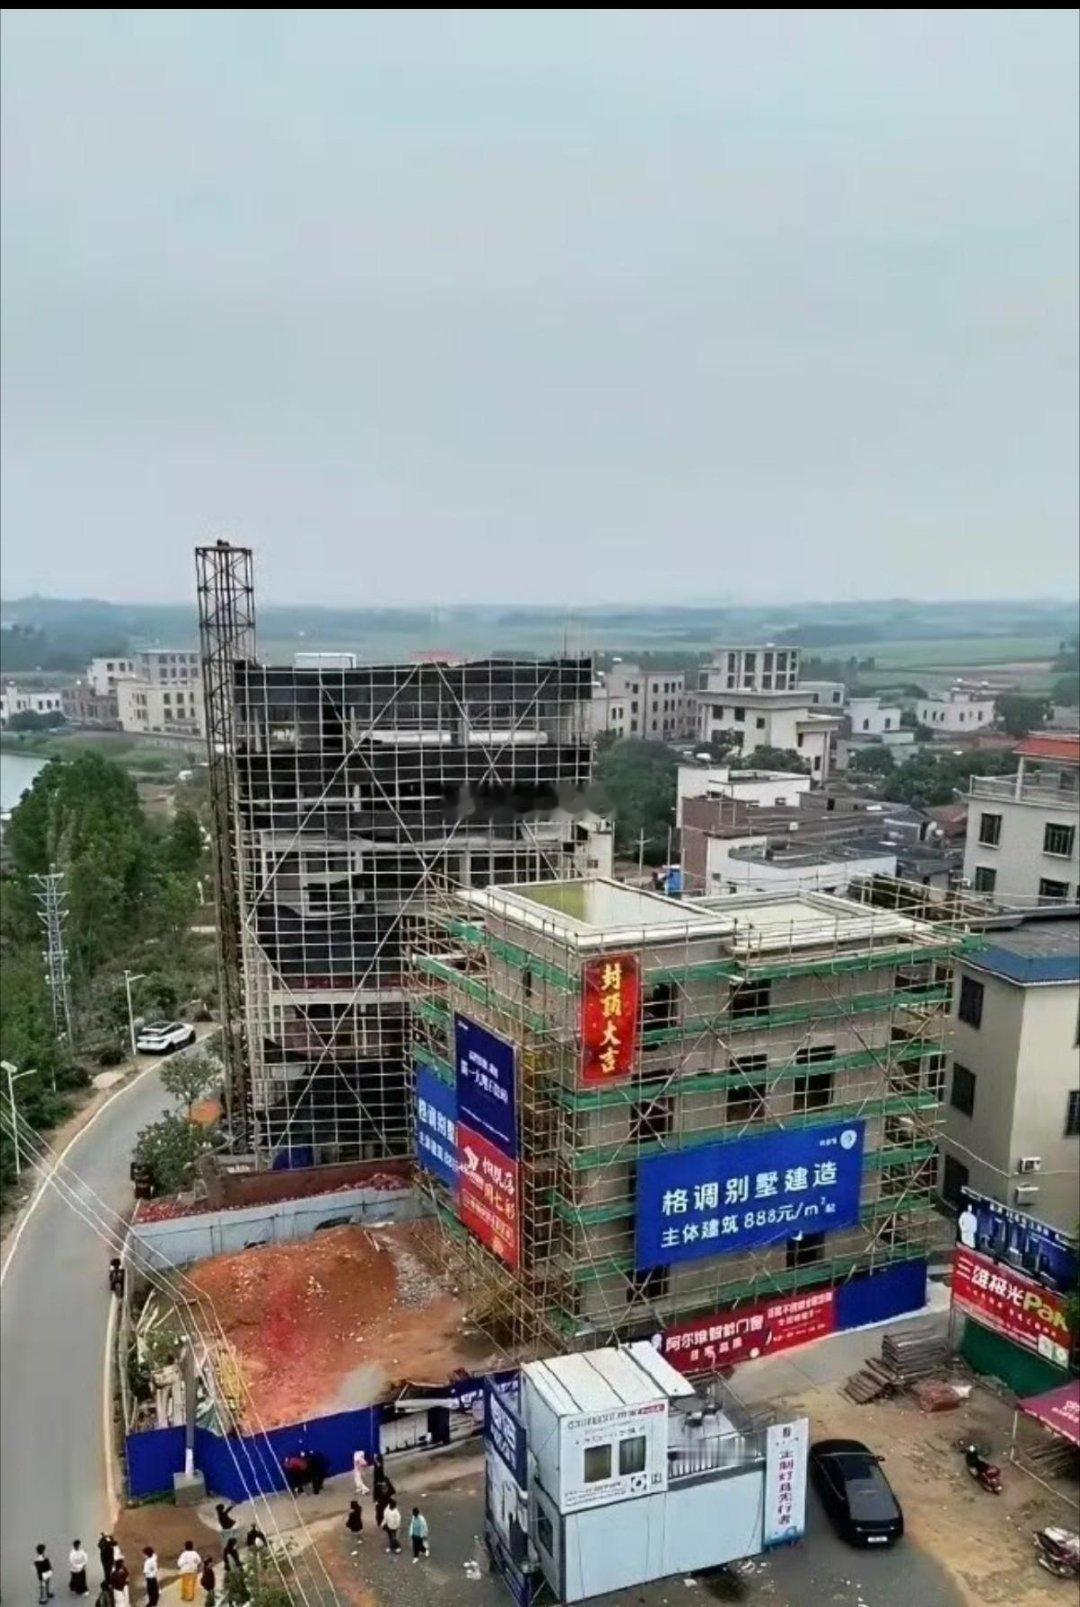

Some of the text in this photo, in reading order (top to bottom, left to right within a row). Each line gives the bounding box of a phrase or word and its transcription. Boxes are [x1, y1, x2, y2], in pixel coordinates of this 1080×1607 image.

[599, 962, 622, 1073] 封顶大吉
[661, 1160, 838, 1216] 格调别墅建造
